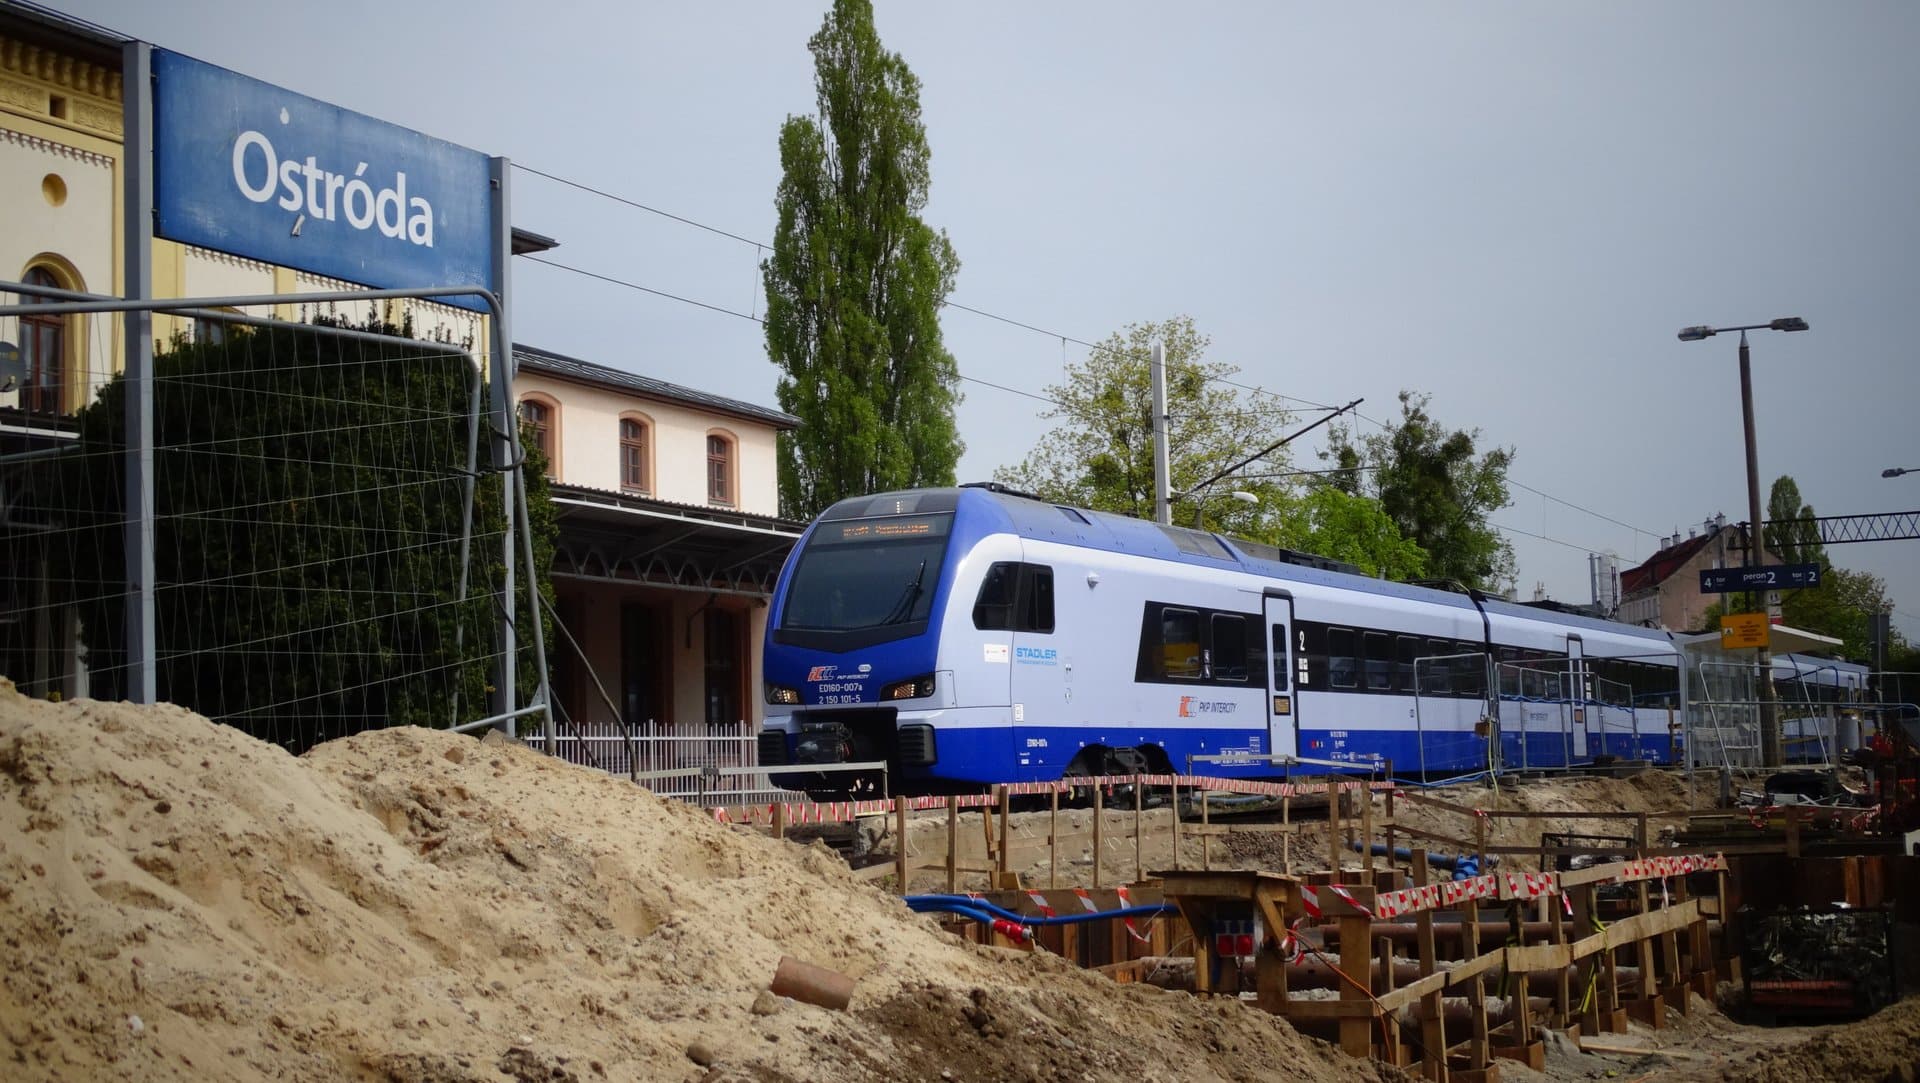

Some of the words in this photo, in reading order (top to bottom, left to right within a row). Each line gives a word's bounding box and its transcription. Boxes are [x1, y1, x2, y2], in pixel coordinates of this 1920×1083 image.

[232, 129, 434, 248] Ostróda
[1704, 577, 1712, 588] 4
[1743, 572, 1767, 580] peron
[1767, 571, 1776, 584] 2
[1808, 571, 1817, 582] 2
[1299, 630, 1306, 651] 2
[1016, 647, 1057, 660] STADLER
[826, 696, 839, 704] 150
[841, 695, 861, 703] 101-5
[1199, 701, 1211, 713] PKP
[1211, 702, 1237, 713] INTERCITY
